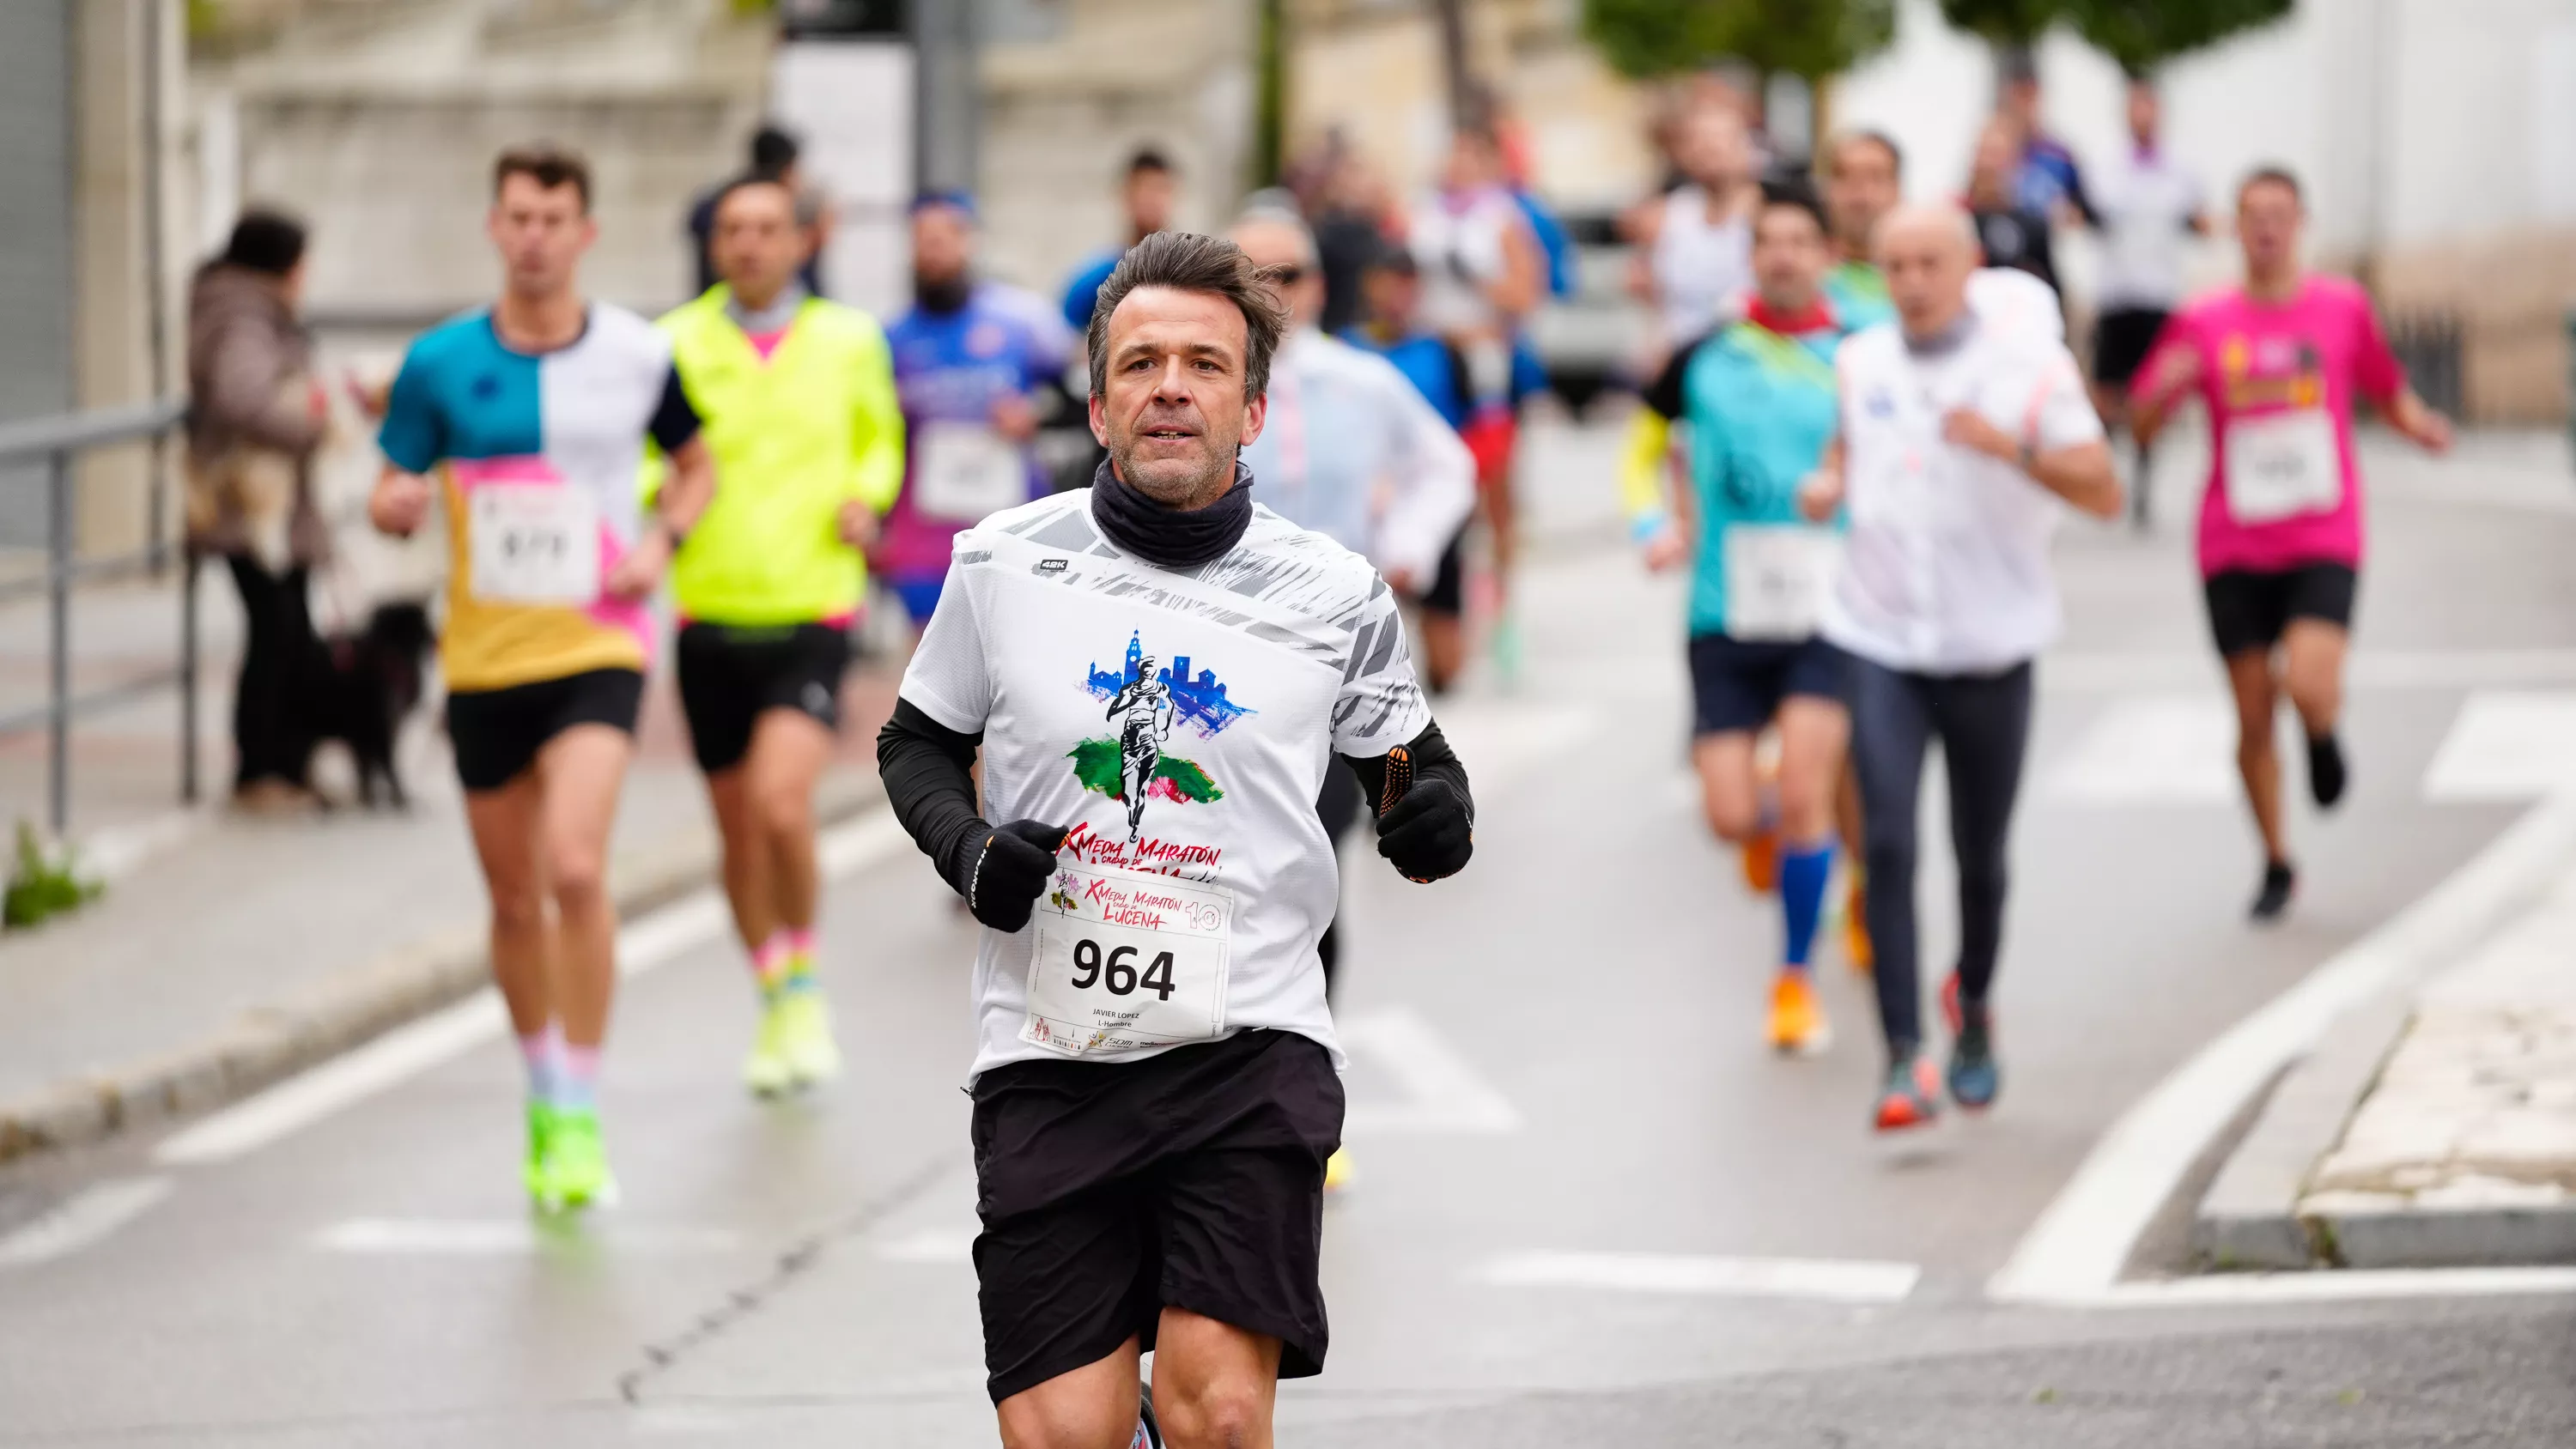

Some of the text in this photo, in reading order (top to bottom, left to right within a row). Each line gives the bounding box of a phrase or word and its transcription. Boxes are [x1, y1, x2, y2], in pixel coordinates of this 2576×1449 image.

[1101, 855, 1128, 865] CIUDAD
[1134, 837, 1221, 866] MARATÓN
[1133, 890, 1182, 912] MARATÓN
[1103, 902, 1168, 931] LUCENA
[1072, 938, 1176, 1002] 964
[1092, 1008, 1116, 1018] JAVIER
